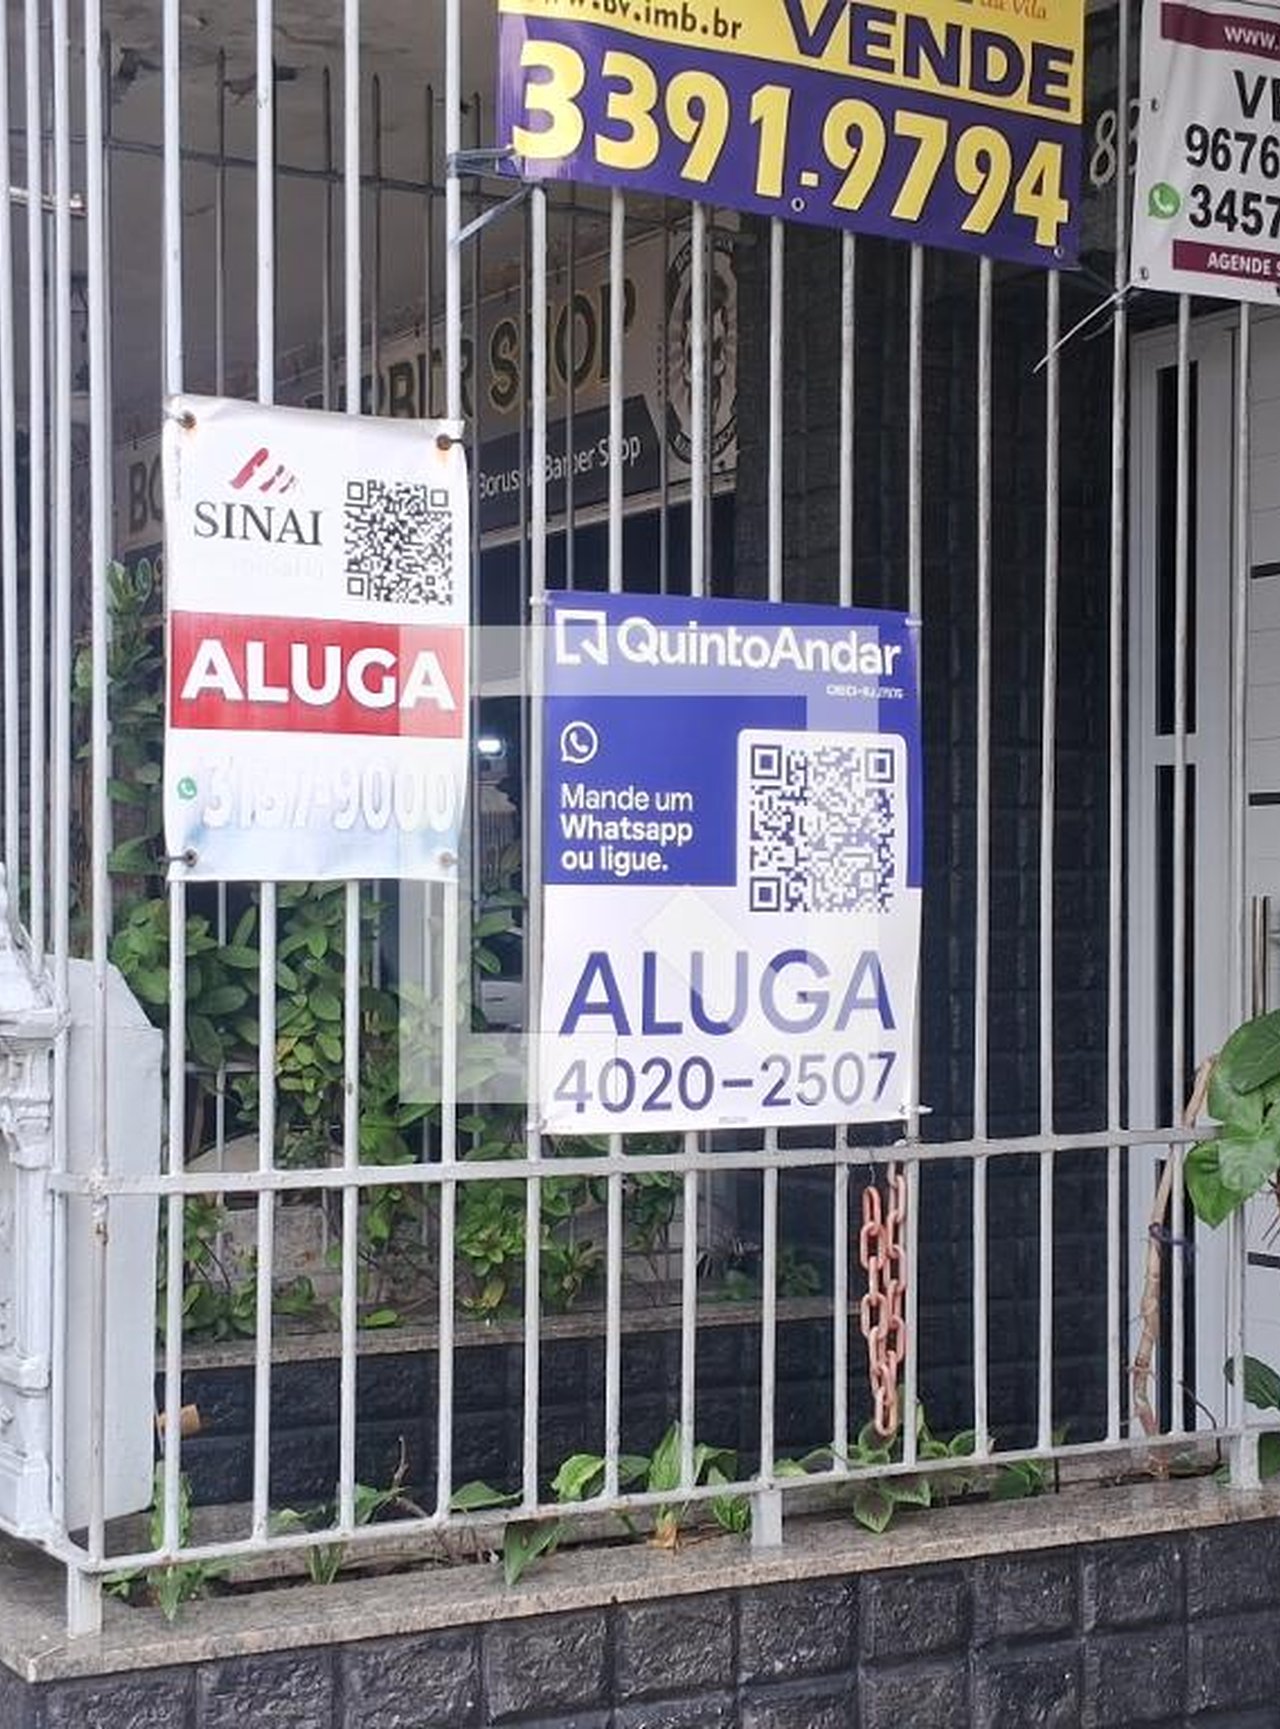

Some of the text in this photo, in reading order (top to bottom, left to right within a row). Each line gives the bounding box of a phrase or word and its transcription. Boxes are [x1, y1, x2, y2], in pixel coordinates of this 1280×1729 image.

[782, 0, 1074, 112] VENDE
[512, 39, 1069, 247] 3391.9794
[1207, 252, 1271, 275] AGENDE
[193, 500, 324, 546] SINAI
[180, 639, 456, 711] ALUGA
[616, 617, 902, 676] QuintoAndar
[561, 784, 693, 811] Mande um
[561, 815, 693, 848] Whatsapp
[561, 846, 668, 877] ou ligue.
[559, 949, 897, 1037] ALUGA
[553, 1051, 897, 1113] 4020-2507
